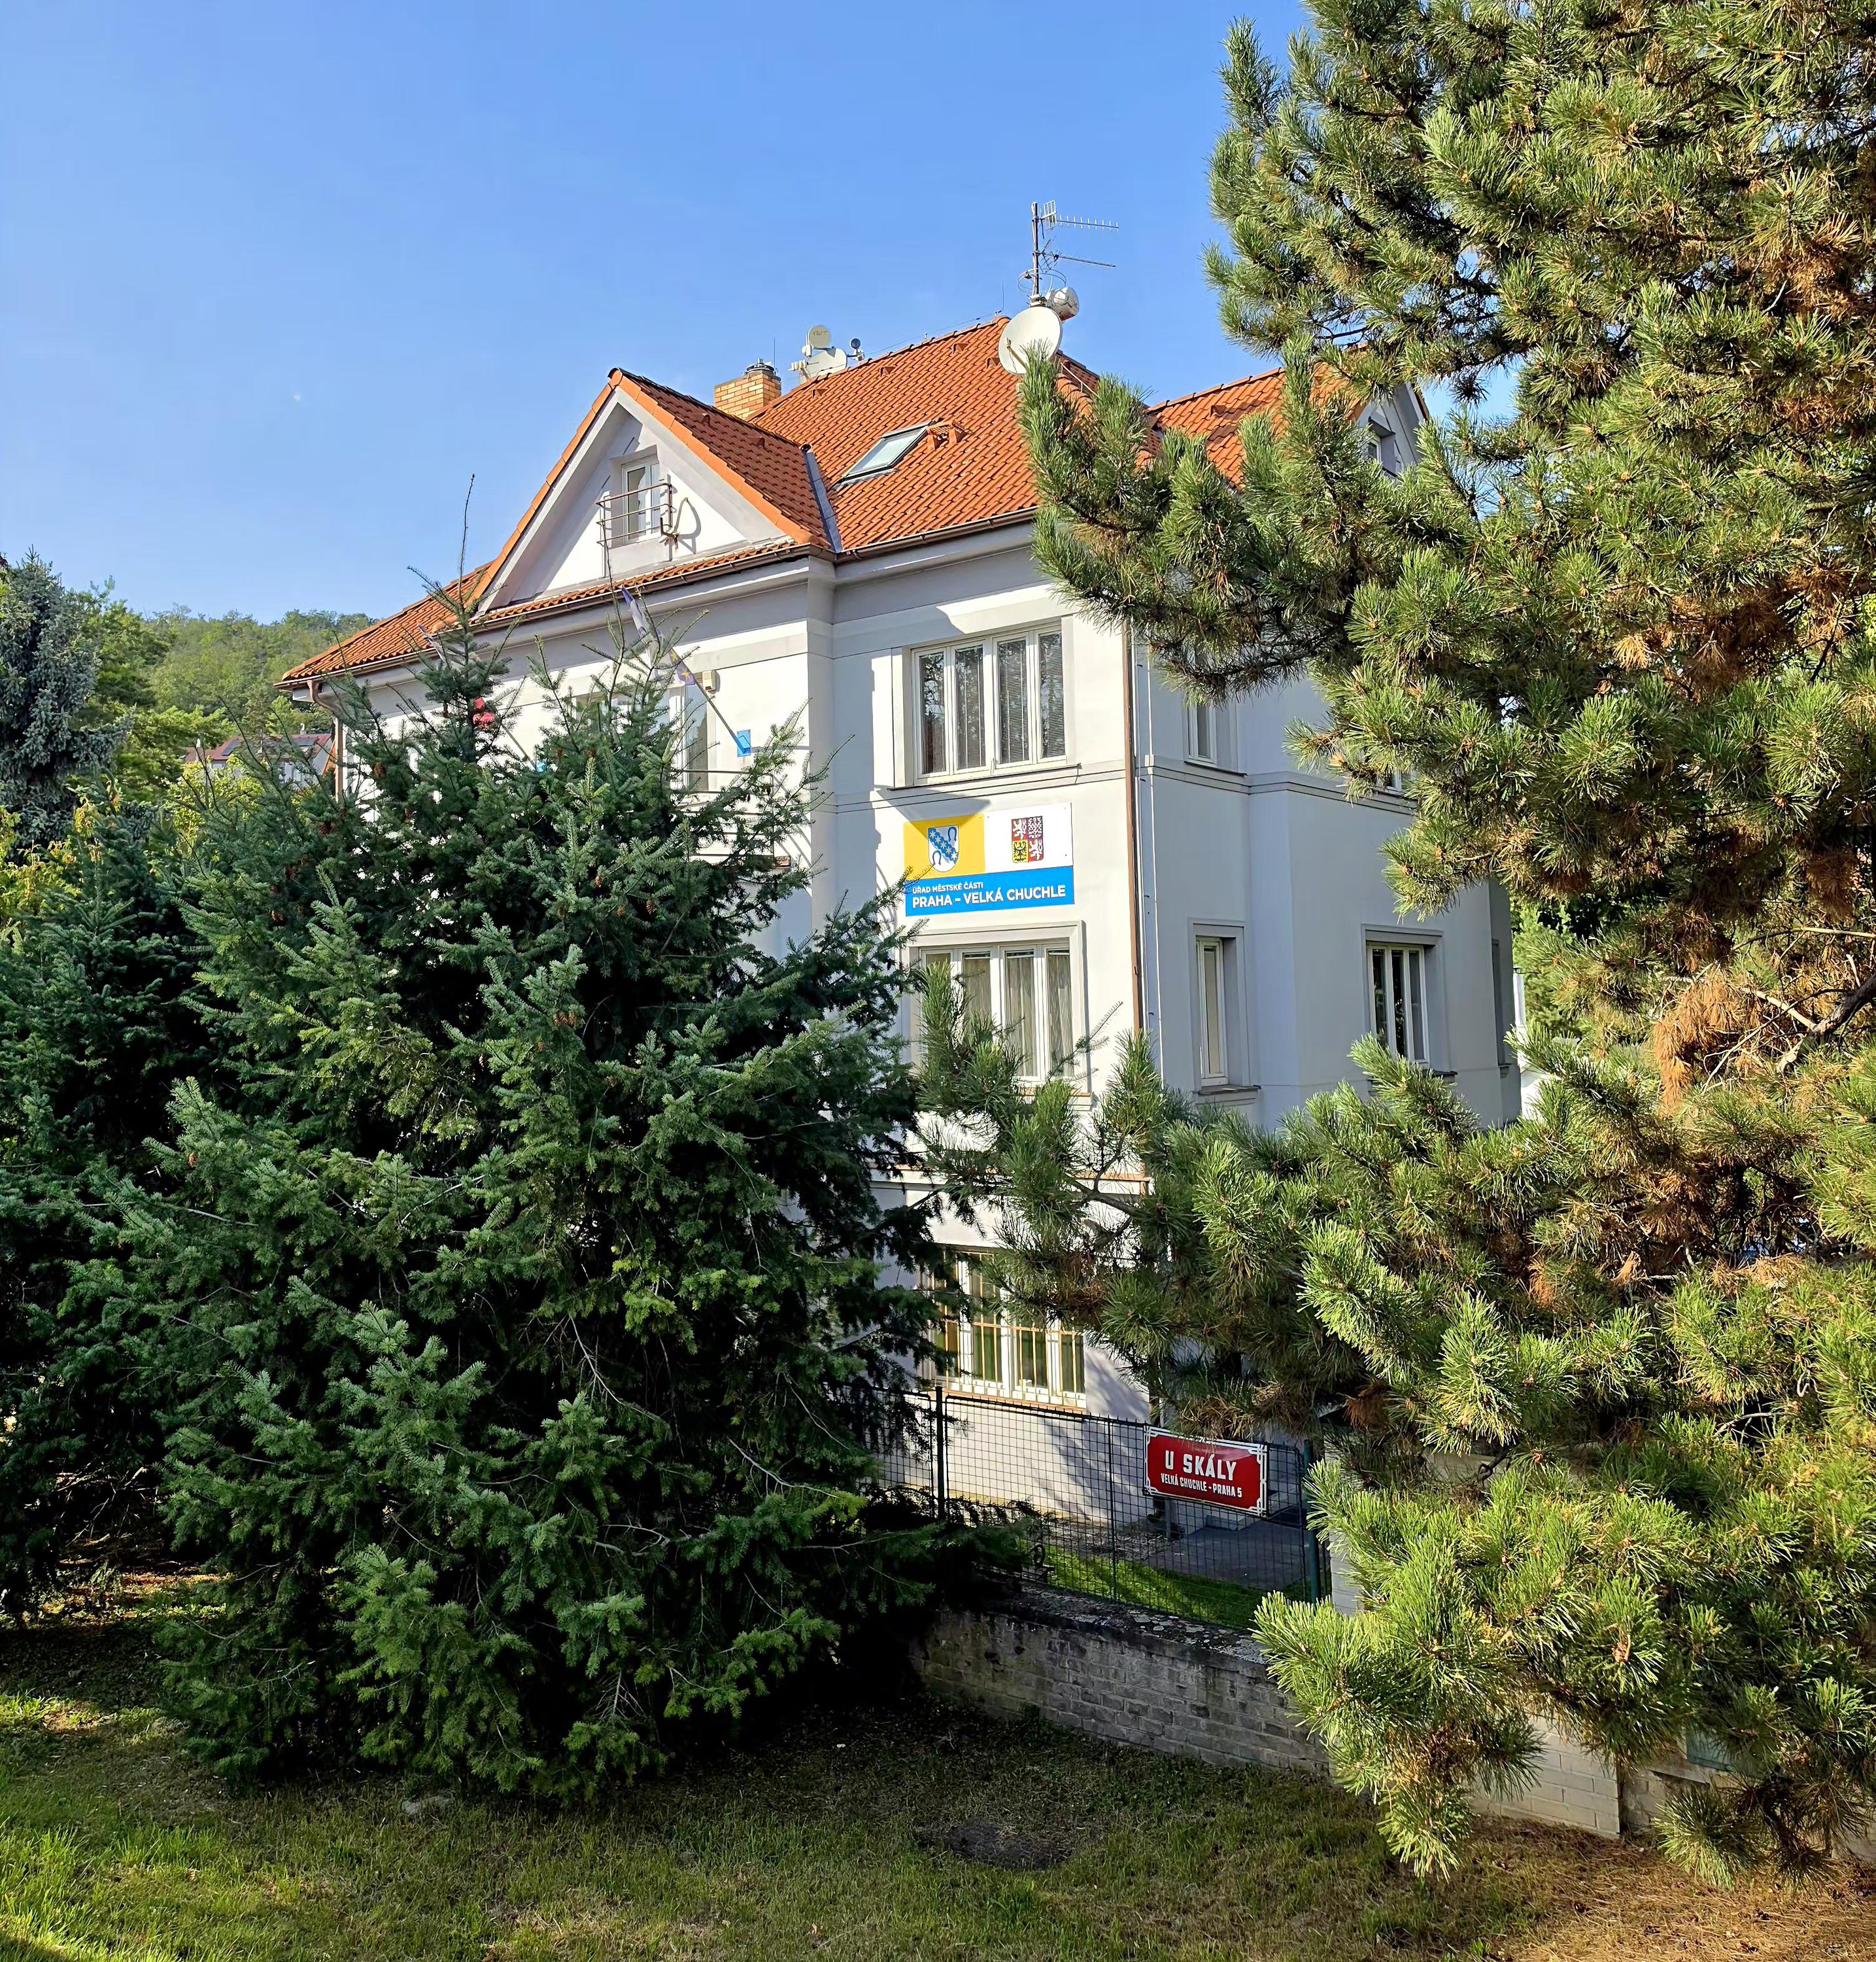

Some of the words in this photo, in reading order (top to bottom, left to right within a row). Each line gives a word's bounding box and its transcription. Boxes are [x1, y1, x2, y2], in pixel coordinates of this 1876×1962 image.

[912, 894, 953, 908] PRAHA
[963, 887, 1004, 904] VELKÁ
[1006, 885, 1066, 901] CHUCHLE
[932, 882, 963, 893] MĚSTSKÉ
[963, 881, 983, 890] ČÁSTI
[1165, 1450, 1174, 1470] U
[1183, 1453, 1236, 1481] SKÁLY
[1161, 1473, 1179, 1486] VELKÁ
[1180, 1477, 1207, 1492] CHUCHLE
[1213, 1483, 1236, 1497] PRAHA
[1237, 1487, 1242, 1498] 5
